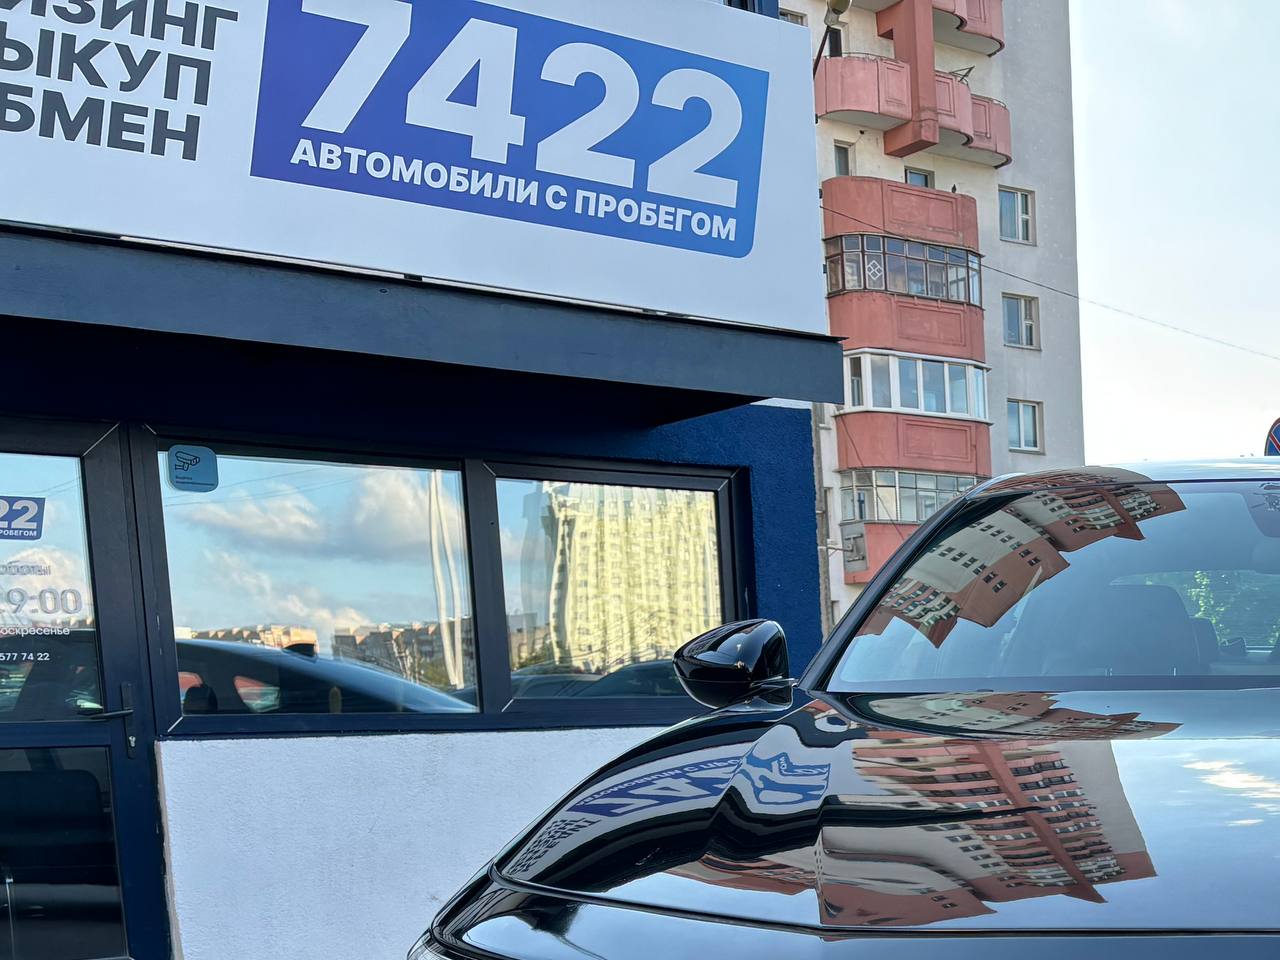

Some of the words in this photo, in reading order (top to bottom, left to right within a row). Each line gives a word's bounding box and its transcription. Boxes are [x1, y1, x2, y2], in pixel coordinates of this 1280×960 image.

[300, 0, 742, 208] 7422
[290, 138, 538, 206] АВТОМОБИЛИ
[544, 184, 568, 210] С
[575, 189, 737, 242] ПРОБЕГОМ
